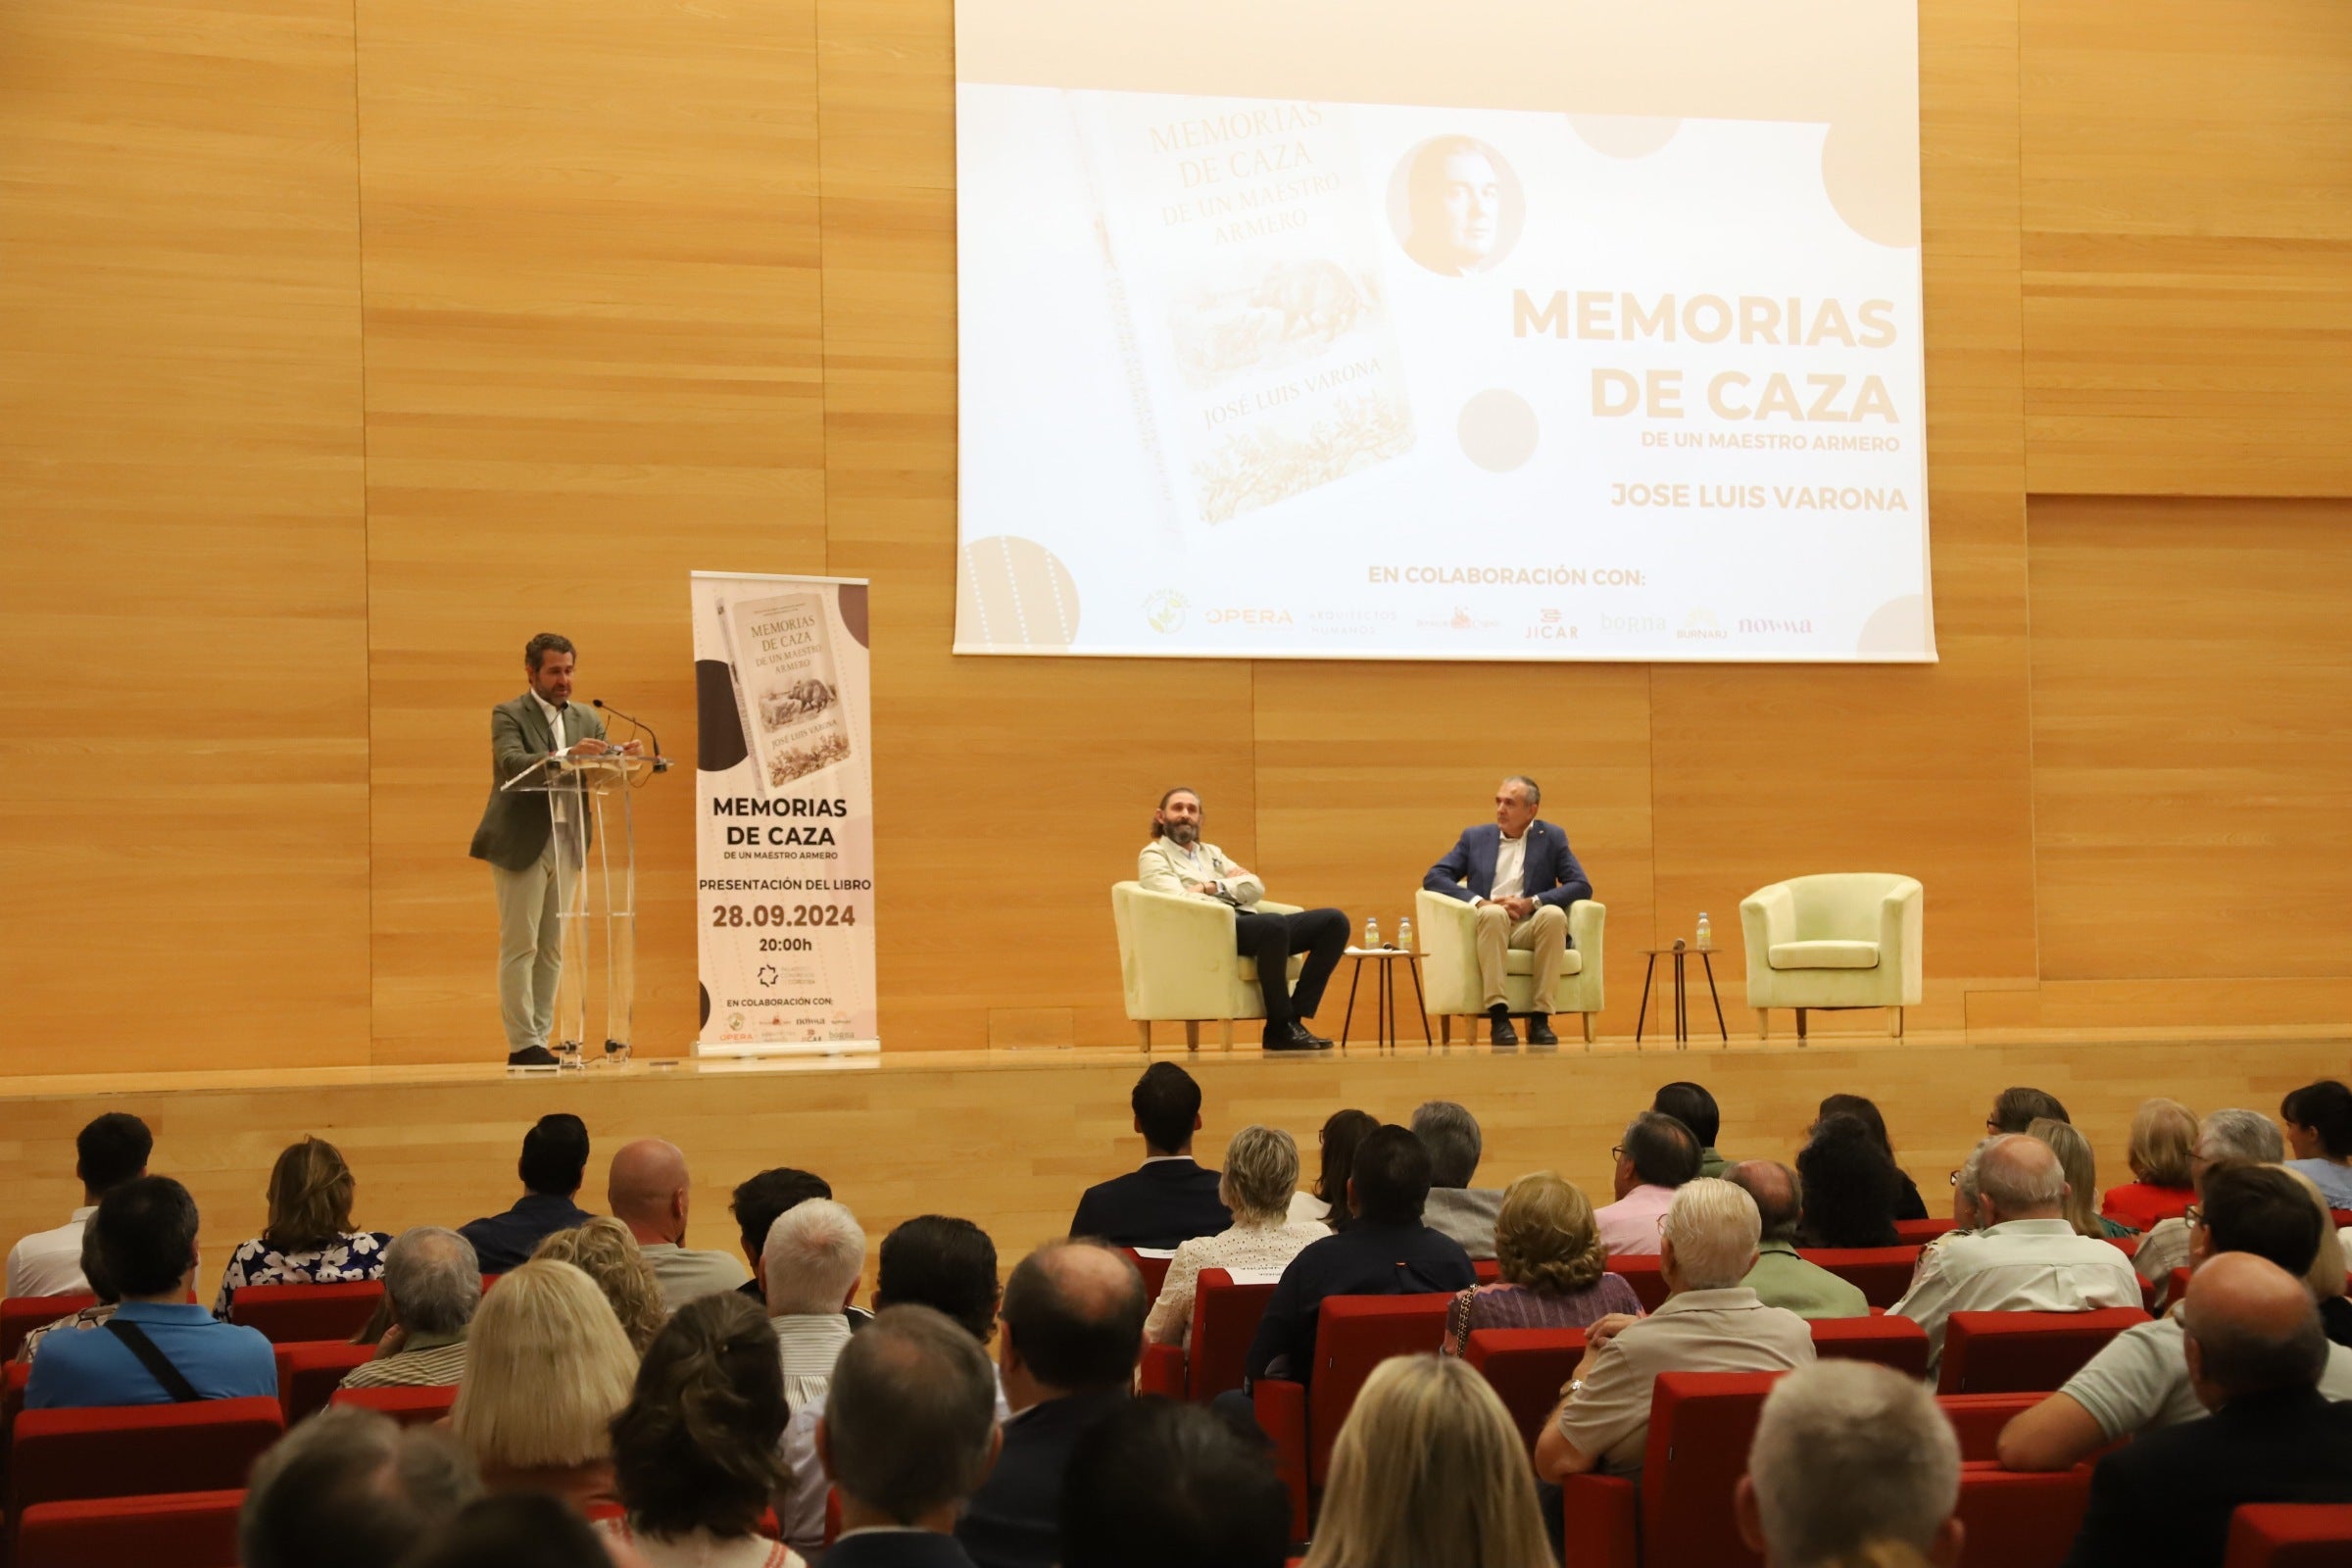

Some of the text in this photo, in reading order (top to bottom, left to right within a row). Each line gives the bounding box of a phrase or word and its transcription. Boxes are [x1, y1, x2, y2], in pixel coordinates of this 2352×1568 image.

[1149, 103, 1323, 154] MEMORIAS
[1179, 140, 1314, 188] DE CAZA
[1161, 172, 1342, 227] DE UN MAESTRO
[1215, 208, 1308, 246] ARMERO
[1512, 288, 1898, 349] MEMORIAS
[1255, 383, 1300, 411] LUIS
[1304, 357, 1381, 393] VARONA
[1591, 368, 1900, 423] DE CAZA
[1641, 431, 1901, 453] DE UN MAESTRO ARMERO
[1611, 482, 1910, 512] JOSE LUIS VARONA
[1368, 564, 1647, 586] EN COLABORACIÓN CON:
[751, 614, 815, 638] MEMORIAS
[1204, 608, 1294, 624] OPERA
[761, 631, 812, 652] DE CAZA
[1525, 625, 1580, 639] JICAR
[713, 797, 848, 817] MEMORIAS
[727, 827, 836, 846] DE CAZA
[800, 851, 838, 859] ARMERO
[699, 877, 871, 891] PRESENTACIÓN DEL LIBRO
[712, 905, 856, 927] 28.09.2024
[760, 938, 812, 952] 20:00h
[727, 997, 833, 1007] EN COLABORACIÓN CON:
